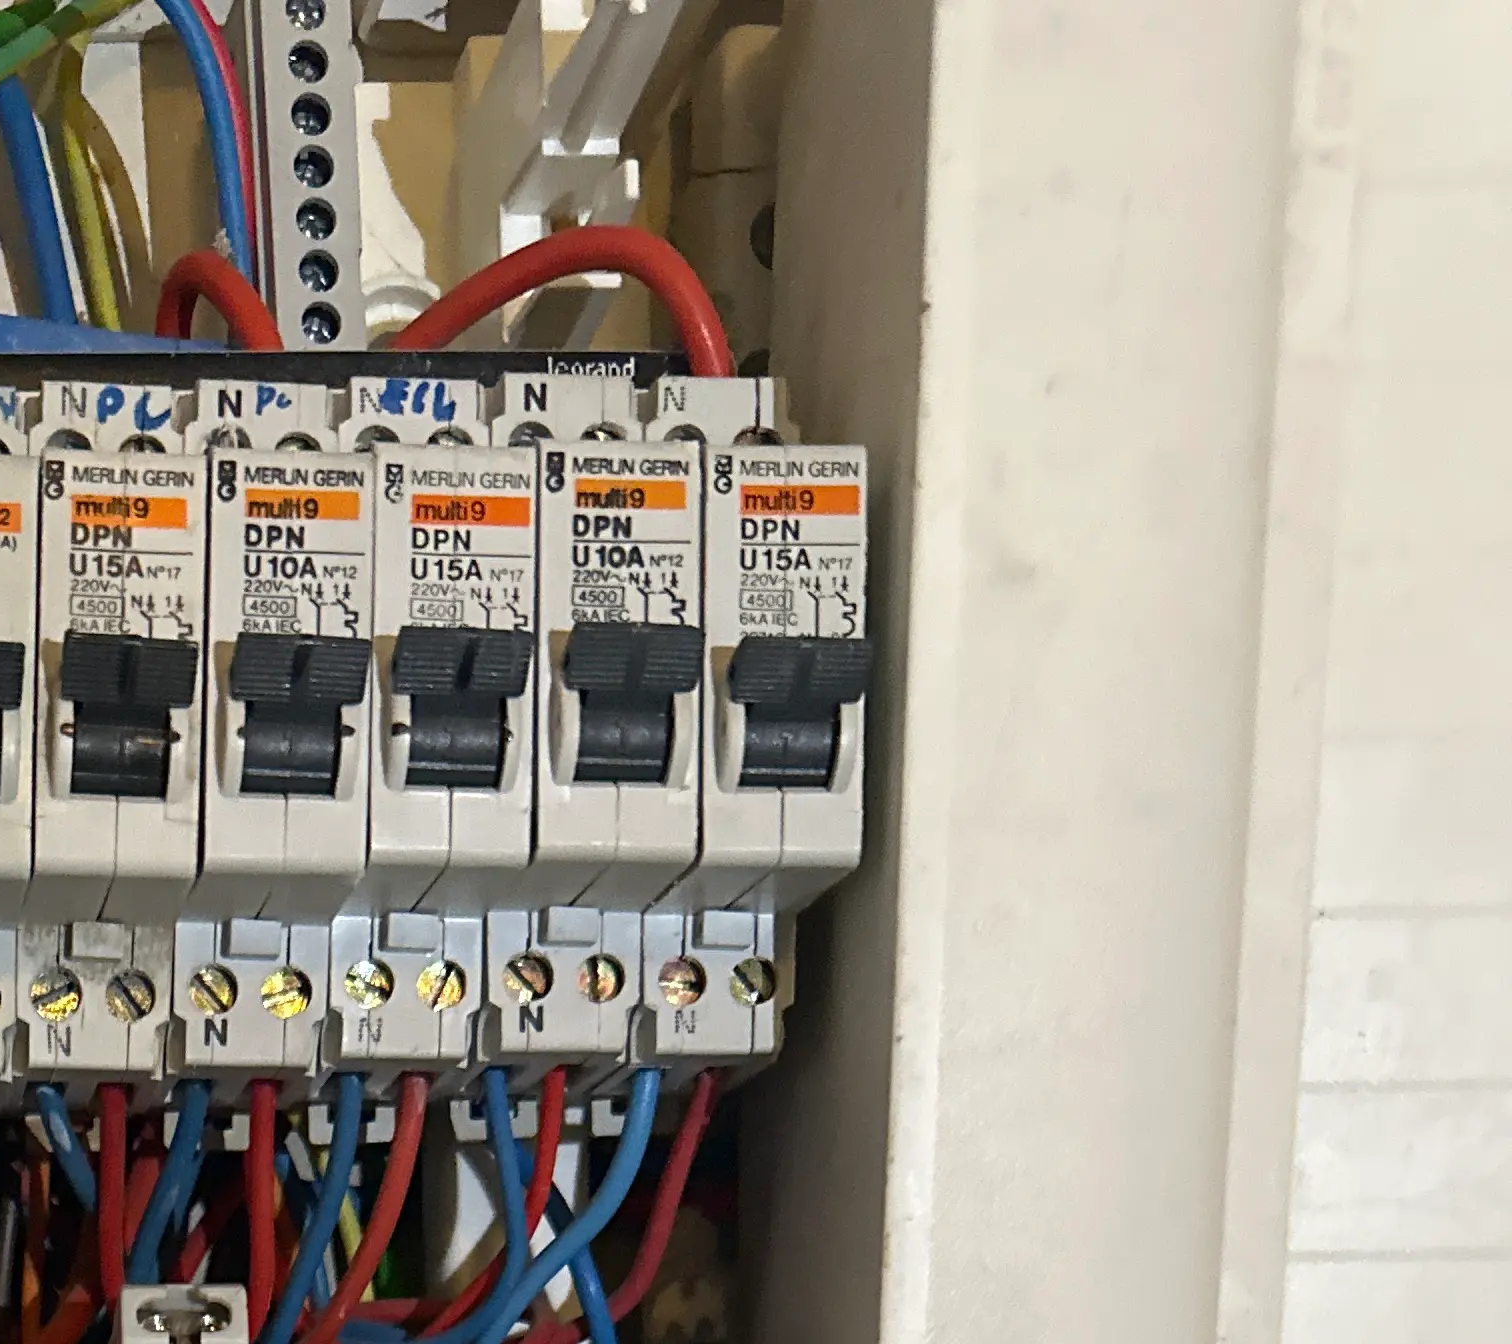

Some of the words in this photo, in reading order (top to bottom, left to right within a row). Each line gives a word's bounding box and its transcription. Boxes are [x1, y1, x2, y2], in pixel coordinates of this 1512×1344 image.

[72, 467, 139, 484] MERLIN
[143, 469, 195, 488] GERIN
[245, 466, 308, 485] MERLIN
[313, 468, 364, 487] GERIN
[572, 458, 635, 475] MERLIN
[639, 459, 689, 476] GERIN
[740, 460, 806, 477] MERLIN
[808, 461, 859, 478] GERIN
[410, 469, 476, 486] MERLIN
[480, 471, 531, 489] GERIN
[70, 526, 132, 548] DPN
[244, 526, 305, 548] DPN
[572, 515, 632, 538] DPN
[740, 519, 801, 541] DPN
[411, 529, 472, 551] DPN
[579, 588, 618, 603] 4500
[249, 600, 290, 615] 4500
